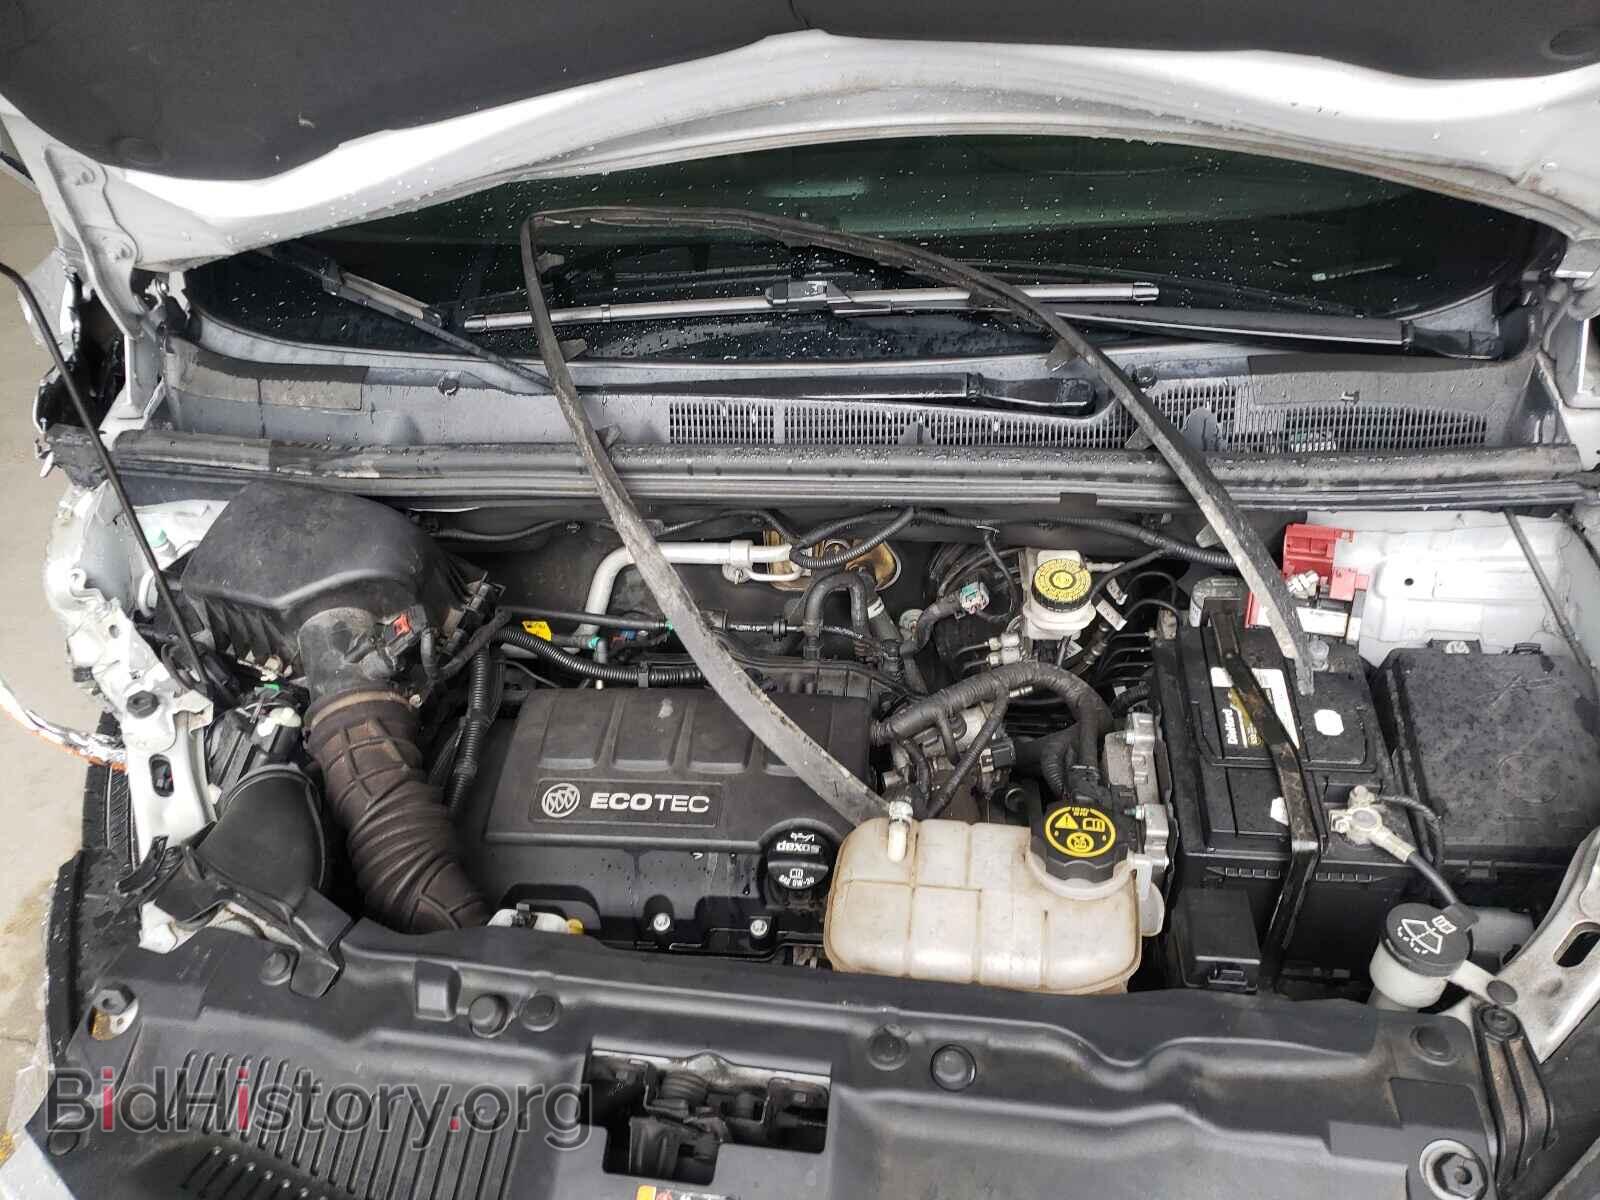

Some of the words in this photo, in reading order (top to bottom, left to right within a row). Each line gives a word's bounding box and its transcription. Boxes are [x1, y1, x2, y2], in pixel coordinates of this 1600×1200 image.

[1222, 708, 1239, 745] DieHard
[590, 792, 711, 813] ECOTEC
[776, 840, 822, 854] dexos
